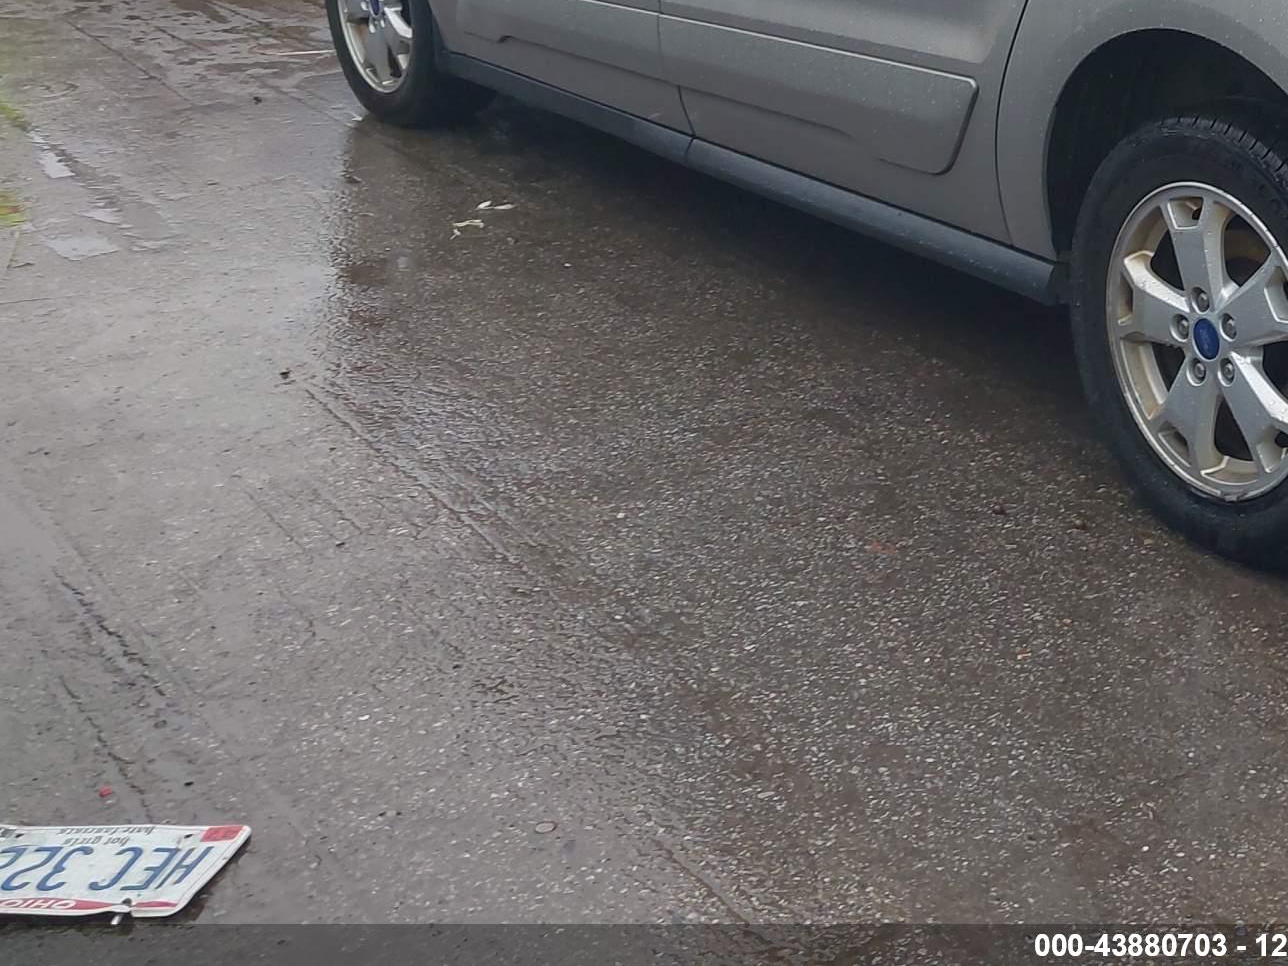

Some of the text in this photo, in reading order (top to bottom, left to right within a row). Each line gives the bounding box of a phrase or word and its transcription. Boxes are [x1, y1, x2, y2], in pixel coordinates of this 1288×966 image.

[63, 836, 130, 847] hot girls
[88, 845, 215, 891] HEC
[0, 899, 77, 910] OHIO
